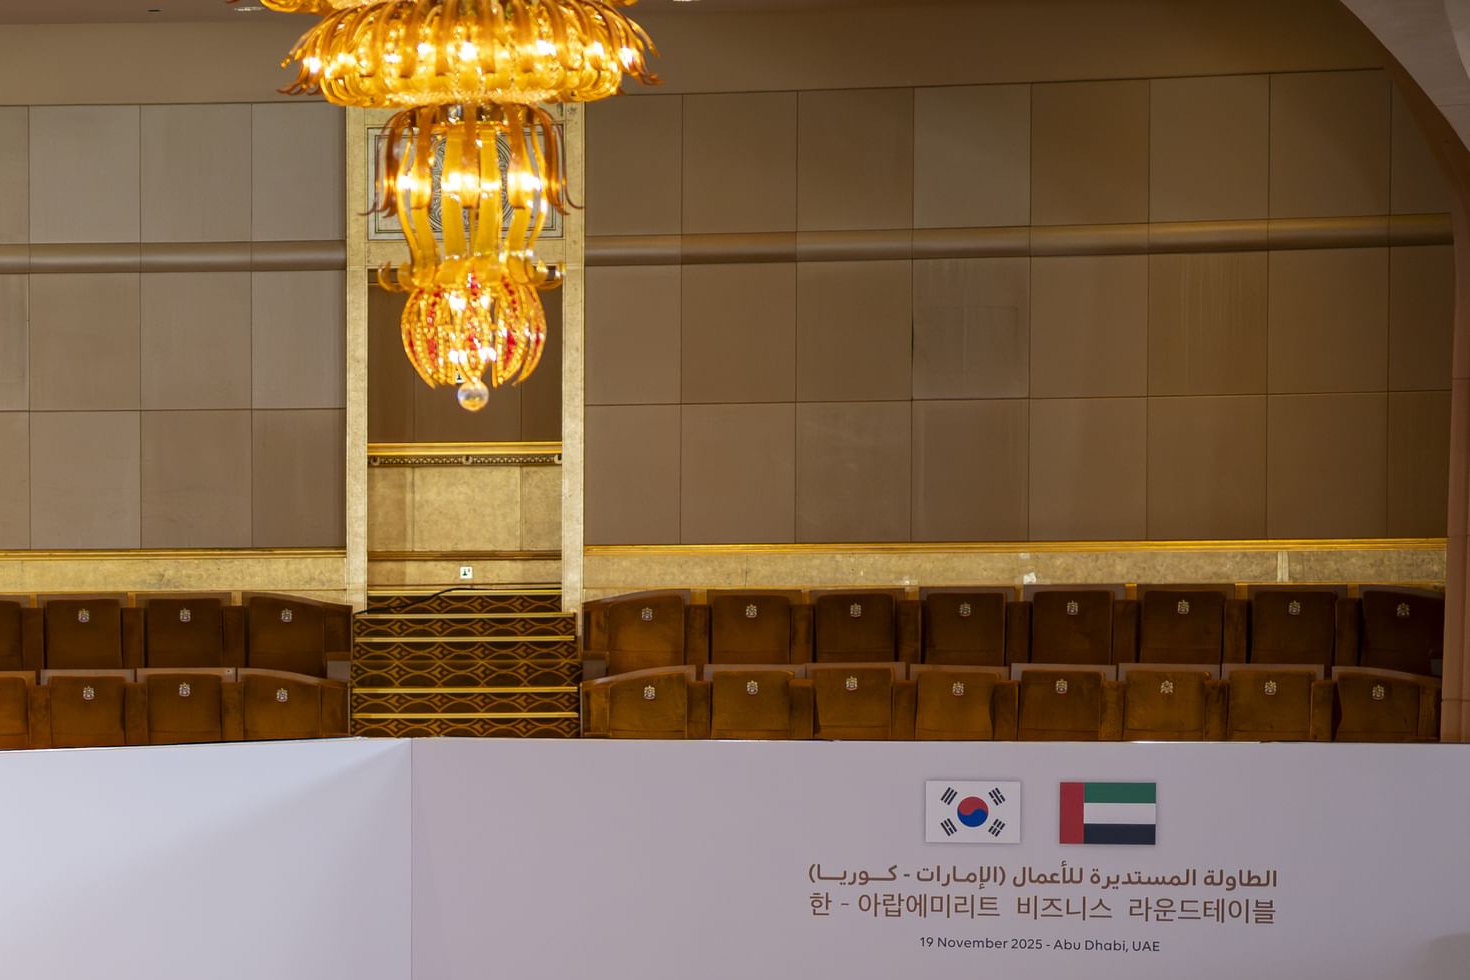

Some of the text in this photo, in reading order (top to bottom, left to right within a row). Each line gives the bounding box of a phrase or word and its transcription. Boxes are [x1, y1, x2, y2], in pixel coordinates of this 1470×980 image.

[916, 865, 1006, 890] (الإمارات
[1012, 860, 1084, 887] للأعمال
[1090, 868, 1197, 890] المستديرة
[1203, 869, 1278, 891] الطاولة
[809, 892, 832, 917] 한
[858, 893, 1001, 919] 아랍에미리트
[1017, 895, 1113, 922] 비즈니스
[1129, 897, 1277, 924] 라운드테이블
[919, 936, 934, 948] 19
[938, 937, 1009, 950] November
[1011, 939, 1043, 950] 2025
[1054, 939, 1080, 950] Abu
[1085, 940, 1129, 952] Dhabi,
[1132, 941, 1160, 952] UAE
